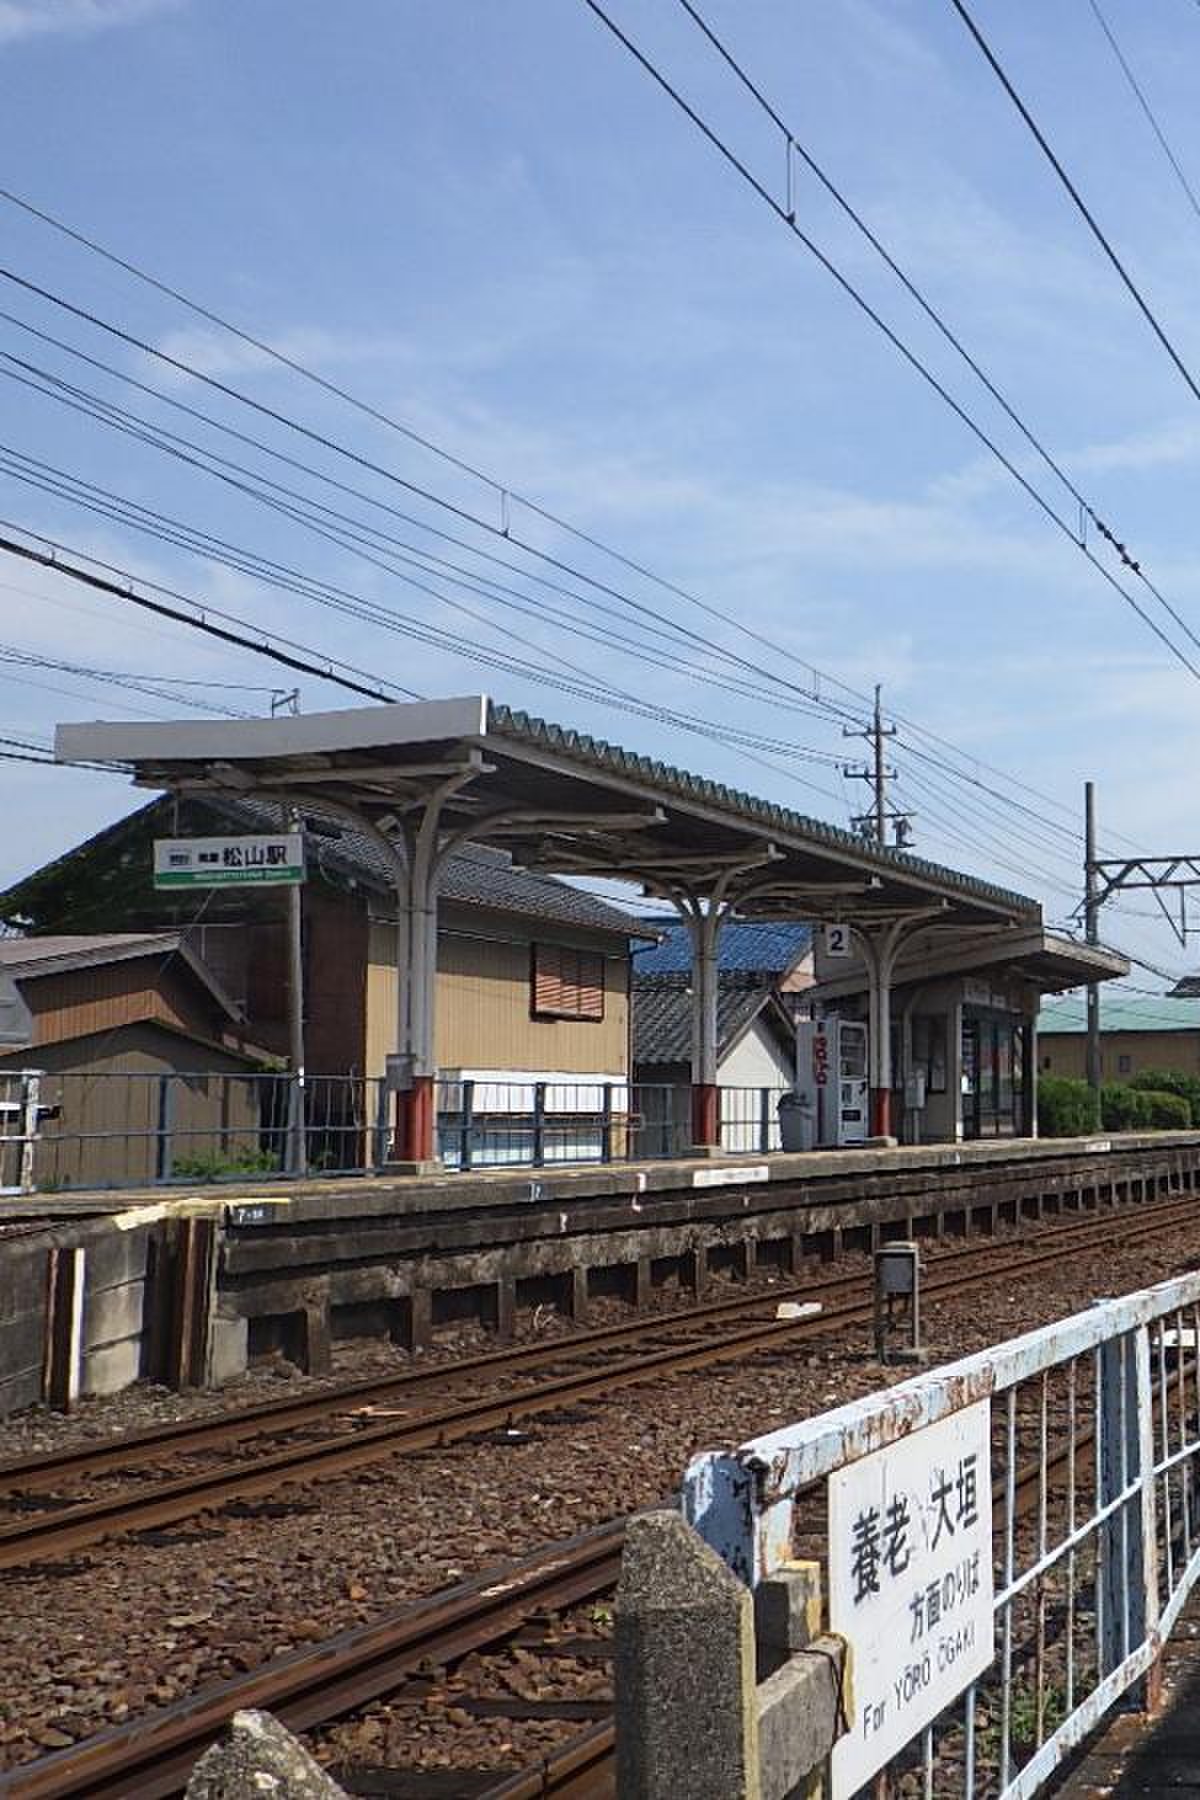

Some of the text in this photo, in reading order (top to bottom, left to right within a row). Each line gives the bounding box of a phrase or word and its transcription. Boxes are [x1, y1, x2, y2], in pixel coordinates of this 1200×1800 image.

[829, 930, 844, 951] 2
[909, 1549, 980, 1643] 方面のりば
[863, 1701, 886, 1740] For
